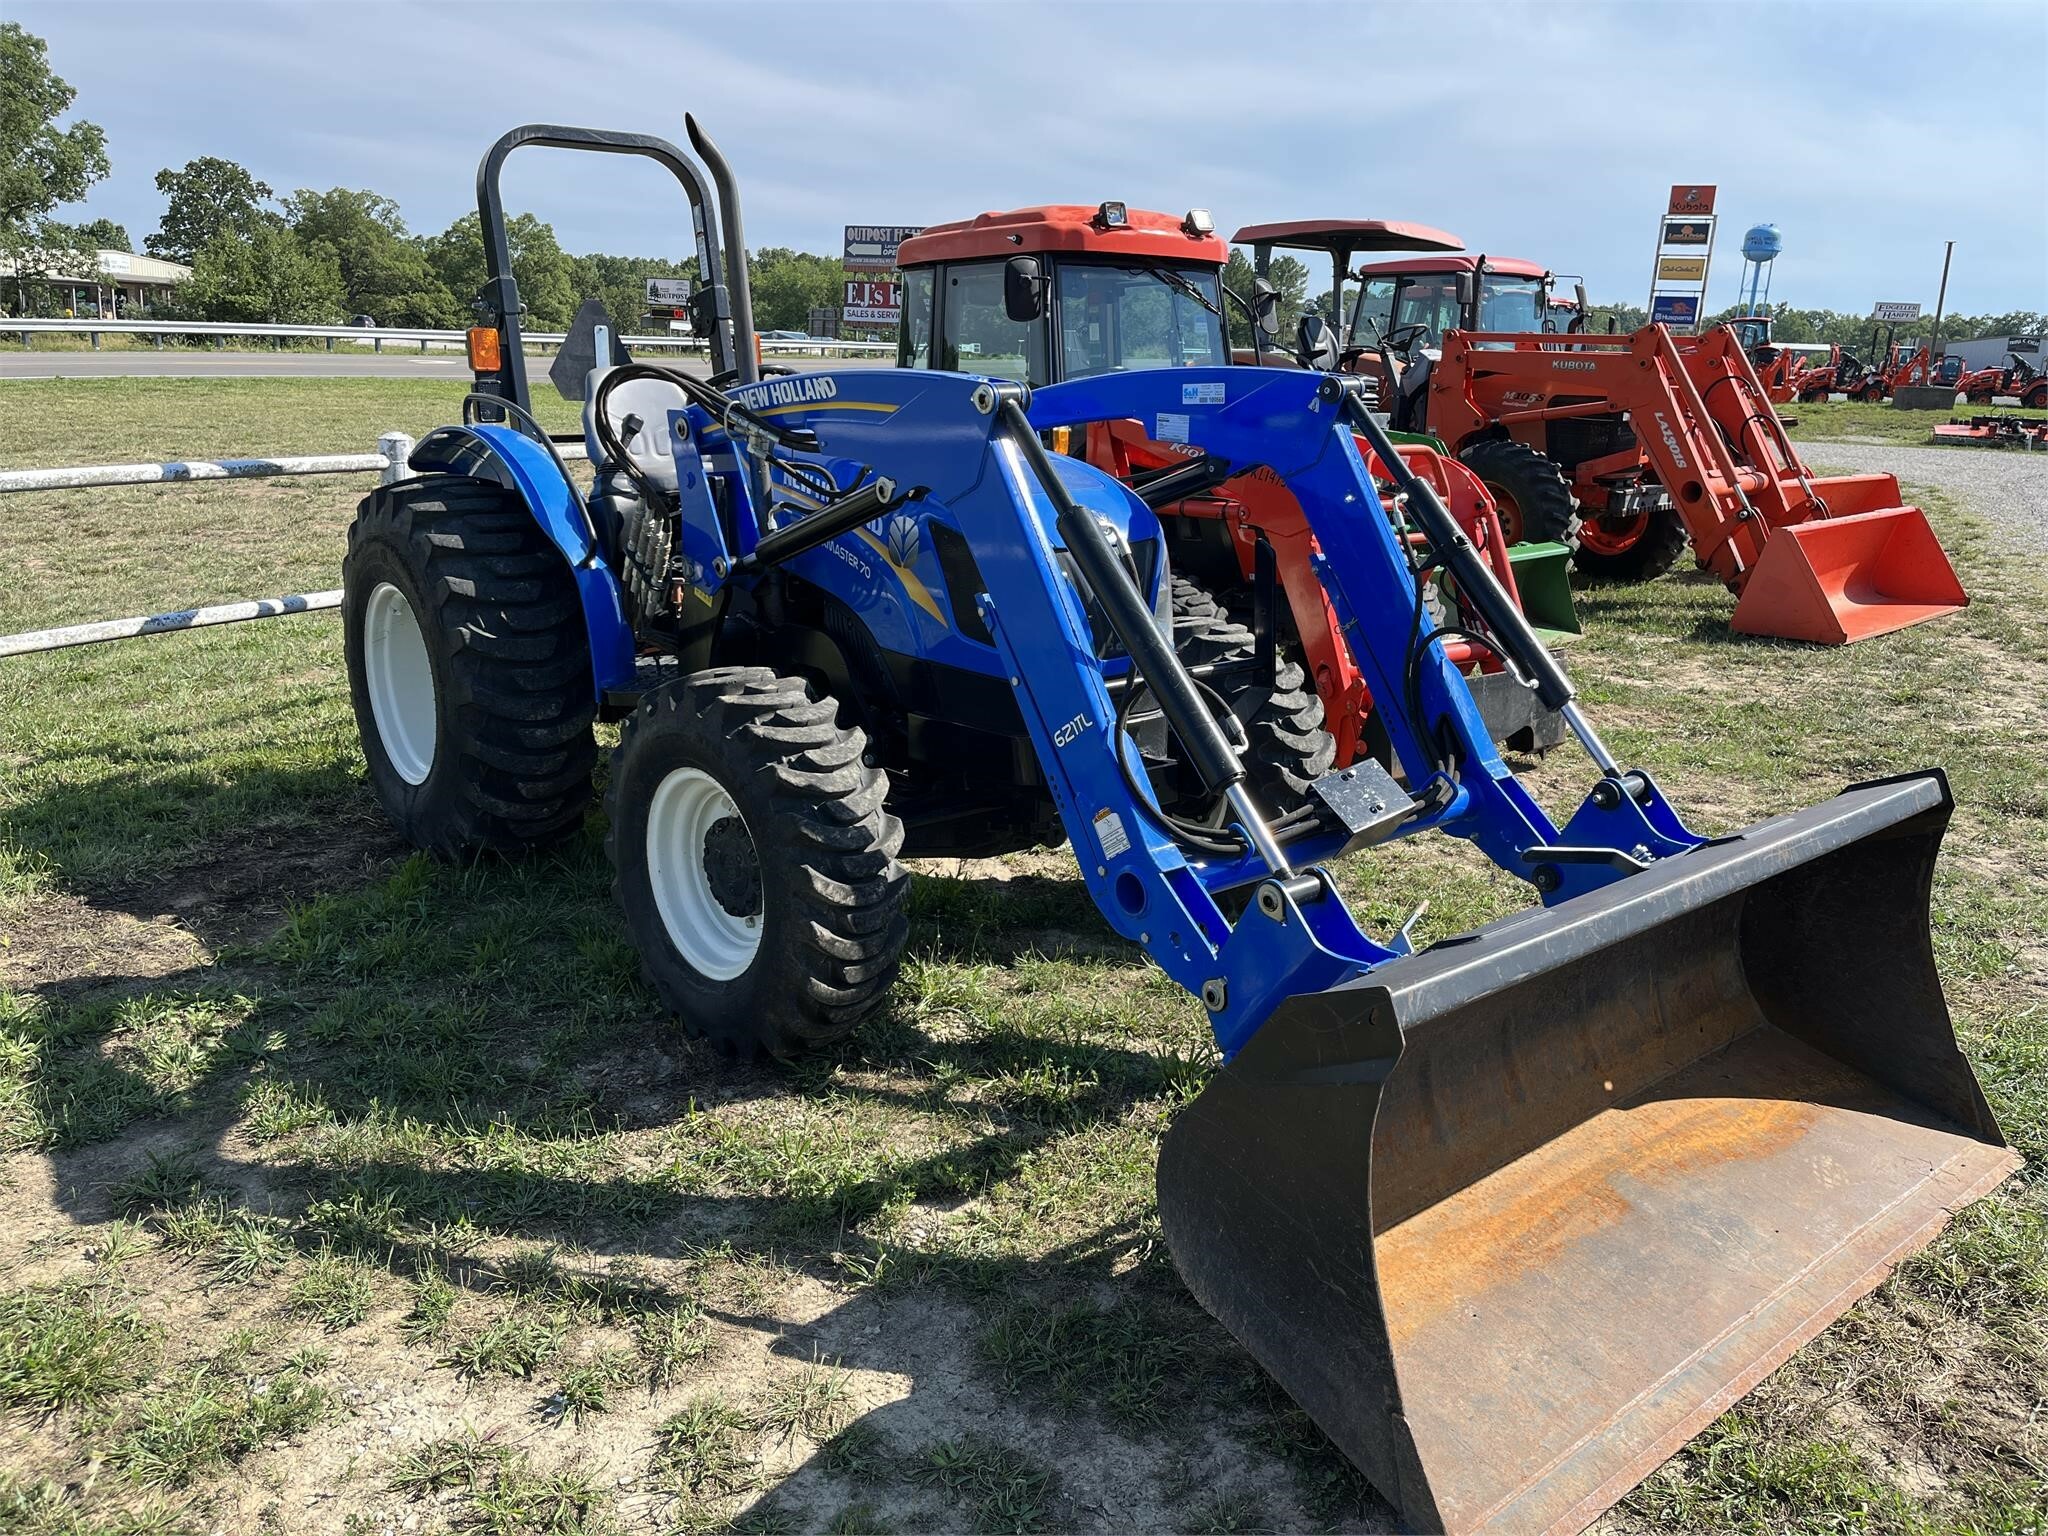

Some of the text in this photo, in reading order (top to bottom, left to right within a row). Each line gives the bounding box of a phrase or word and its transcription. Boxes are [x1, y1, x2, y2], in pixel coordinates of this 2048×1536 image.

[1672, 202, 1709, 211] Kubota
[847, 227, 892, 242] OUTPOST
[847, 282, 884, 308] E.J.'s
[847, 309, 869, 318] SALES
[870, 310, 876, 319] &
[1552, 360, 1597, 370] KUBOTA
[739, 376, 837, 410] NEW HOLLAND
[1503, 391, 1546, 403] M105S
[1654, 412, 1687, 469] LA1301S
[859, 561, 871, 579] 70
[1054, 713, 1093, 748] 621TL
